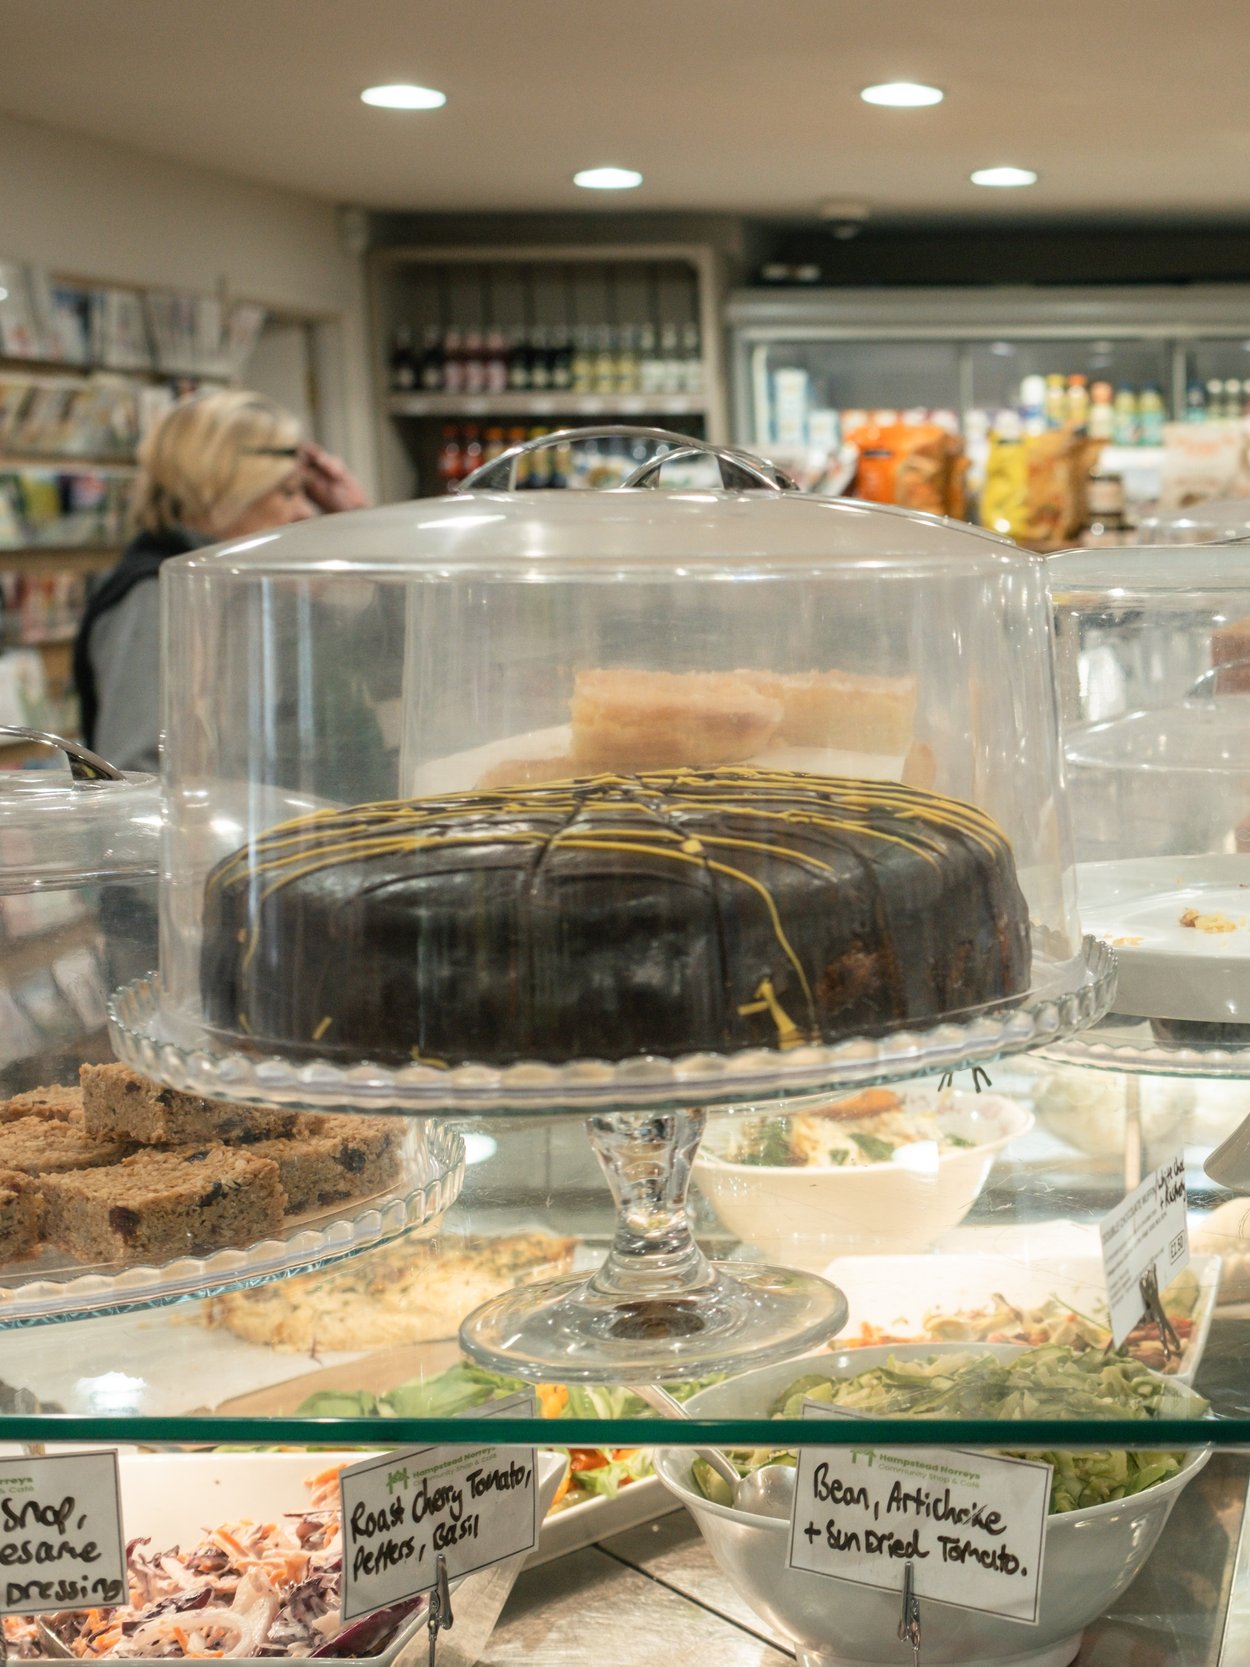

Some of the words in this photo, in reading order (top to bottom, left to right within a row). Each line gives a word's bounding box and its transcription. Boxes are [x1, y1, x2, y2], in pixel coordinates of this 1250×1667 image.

[413, 1456, 463, 1478] Hampstead
[879, 1454, 938, 1471] Hampstead
[940, 1465, 980, 1480] Norreys
[351, 1496, 405, 1544] Roast
[412, 1477, 463, 1523] Cherry
[466, 1460, 532, 1499] Tomato,
[814, 1462, 880, 1520] Bean,
[433, 1514, 479, 1551] Basil
[0, 1540, 102, 1565] esame
[937, 1535, 1028, 1577] Tomato.
